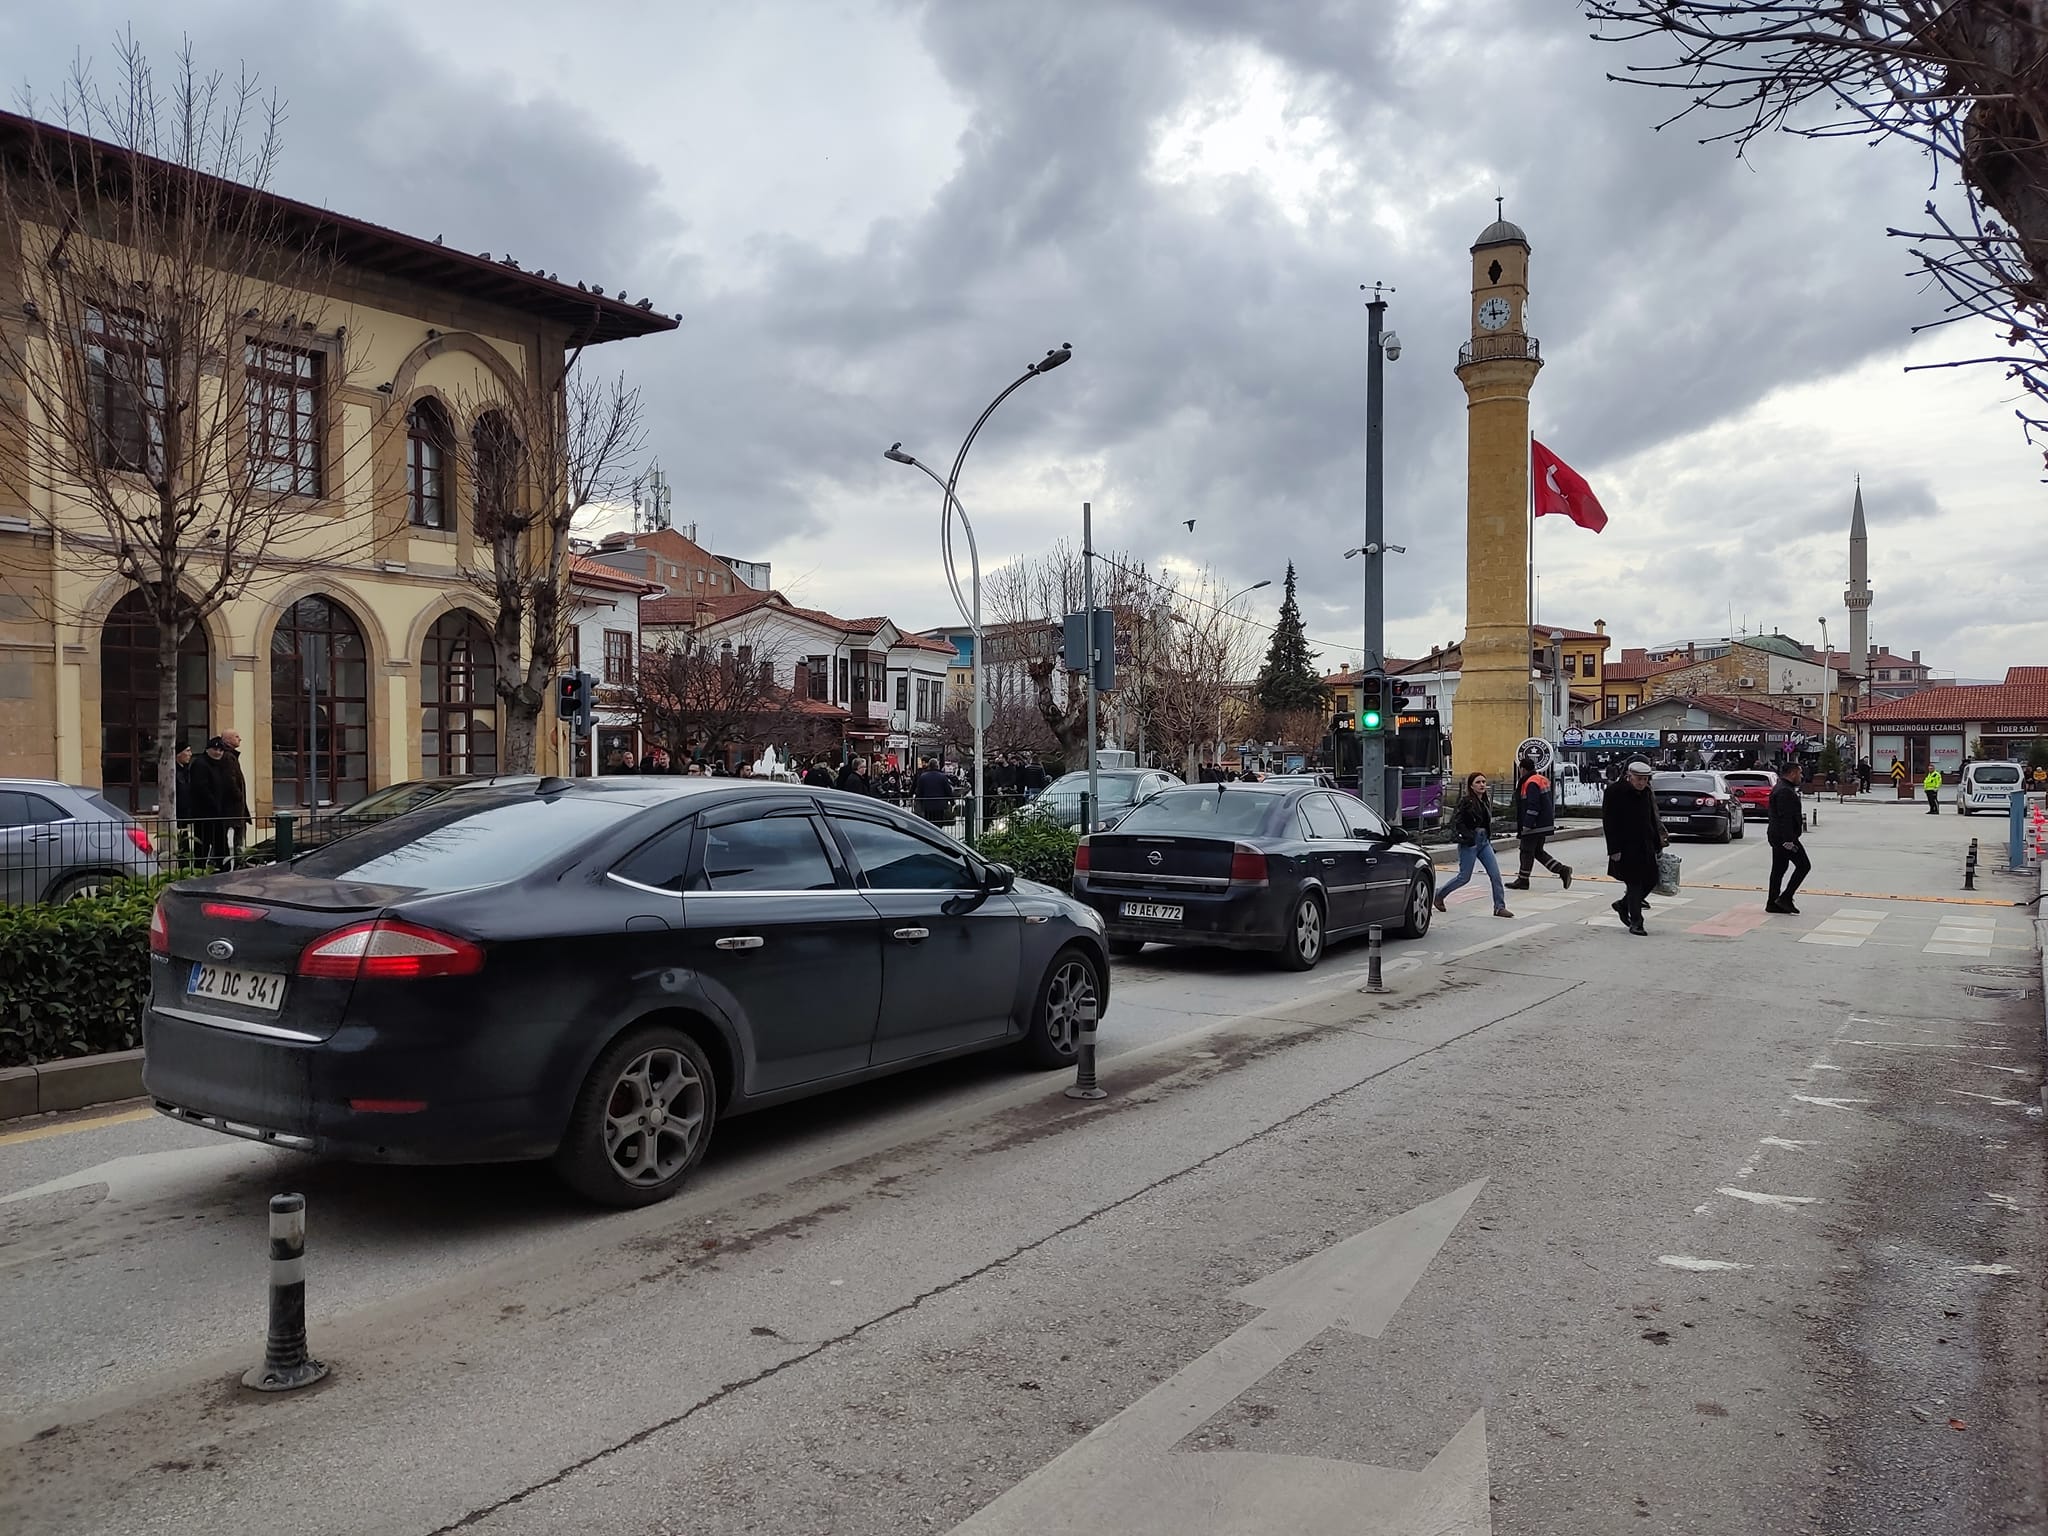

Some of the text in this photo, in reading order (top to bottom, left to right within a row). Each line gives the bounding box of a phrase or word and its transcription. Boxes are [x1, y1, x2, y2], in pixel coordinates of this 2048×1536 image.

[1588, 731, 1655, 740] KARADENİZ
[1126, 903, 1181, 919] 19 AEK 772
[198, 968, 278, 1004] 22 DC 341
